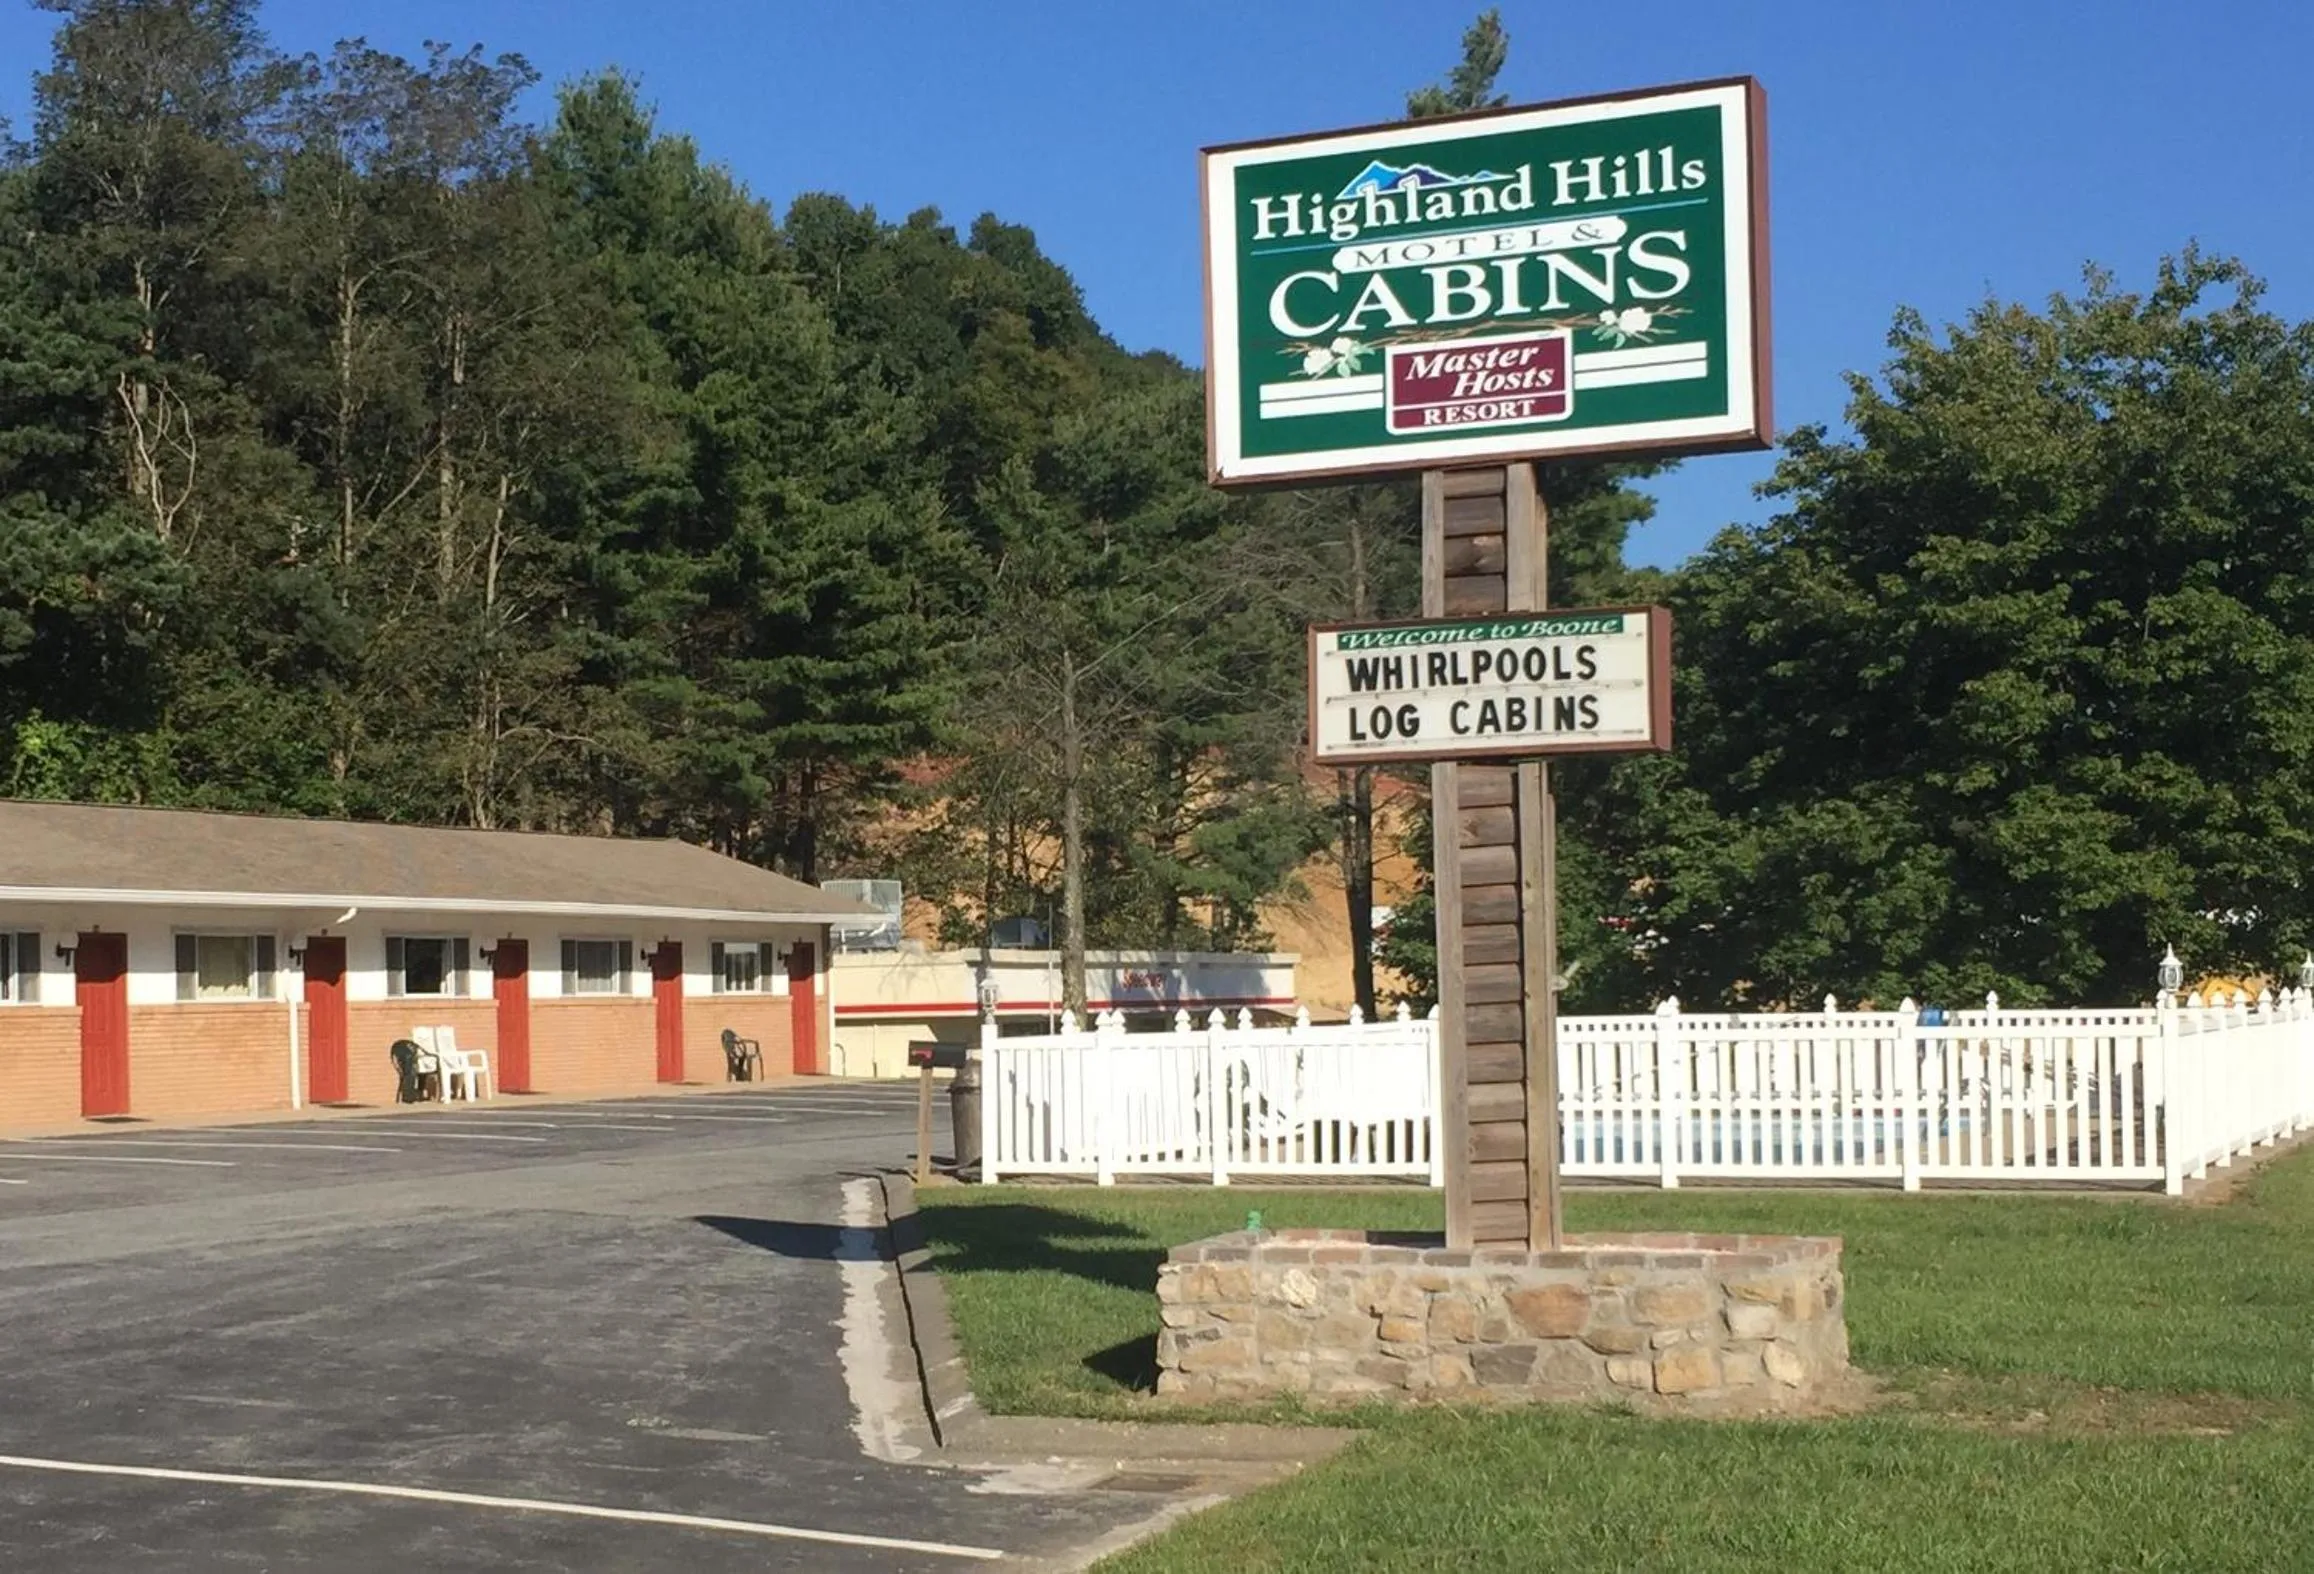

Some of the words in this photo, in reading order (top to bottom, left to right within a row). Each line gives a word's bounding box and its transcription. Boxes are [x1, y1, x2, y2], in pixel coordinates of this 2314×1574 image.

[1250, 165, 1532, 241] Highland
[1548, 145, 1706, 205] Hills
[1355, 228, 1554, 268] MOTEL
[1570, 219, 1605, 243] &
[1268, 228, 1692, 338] CABINS
[1405, 347, 1540, 381] Master
[1451, 367, 1555, 398] Hosts
[1423, 400, 1536, 426] RESORT
[1341, 626, 1484, 649] Welcome
[1490, 623, 1517, 639] to
[1521, 618, 1620, 637] Boone
[1345, 645, 1598, 693] WHIRLPOOLS
[1350, 704, 1420, 741] LOG
[1450, 695, 1599, 735] CABINS
